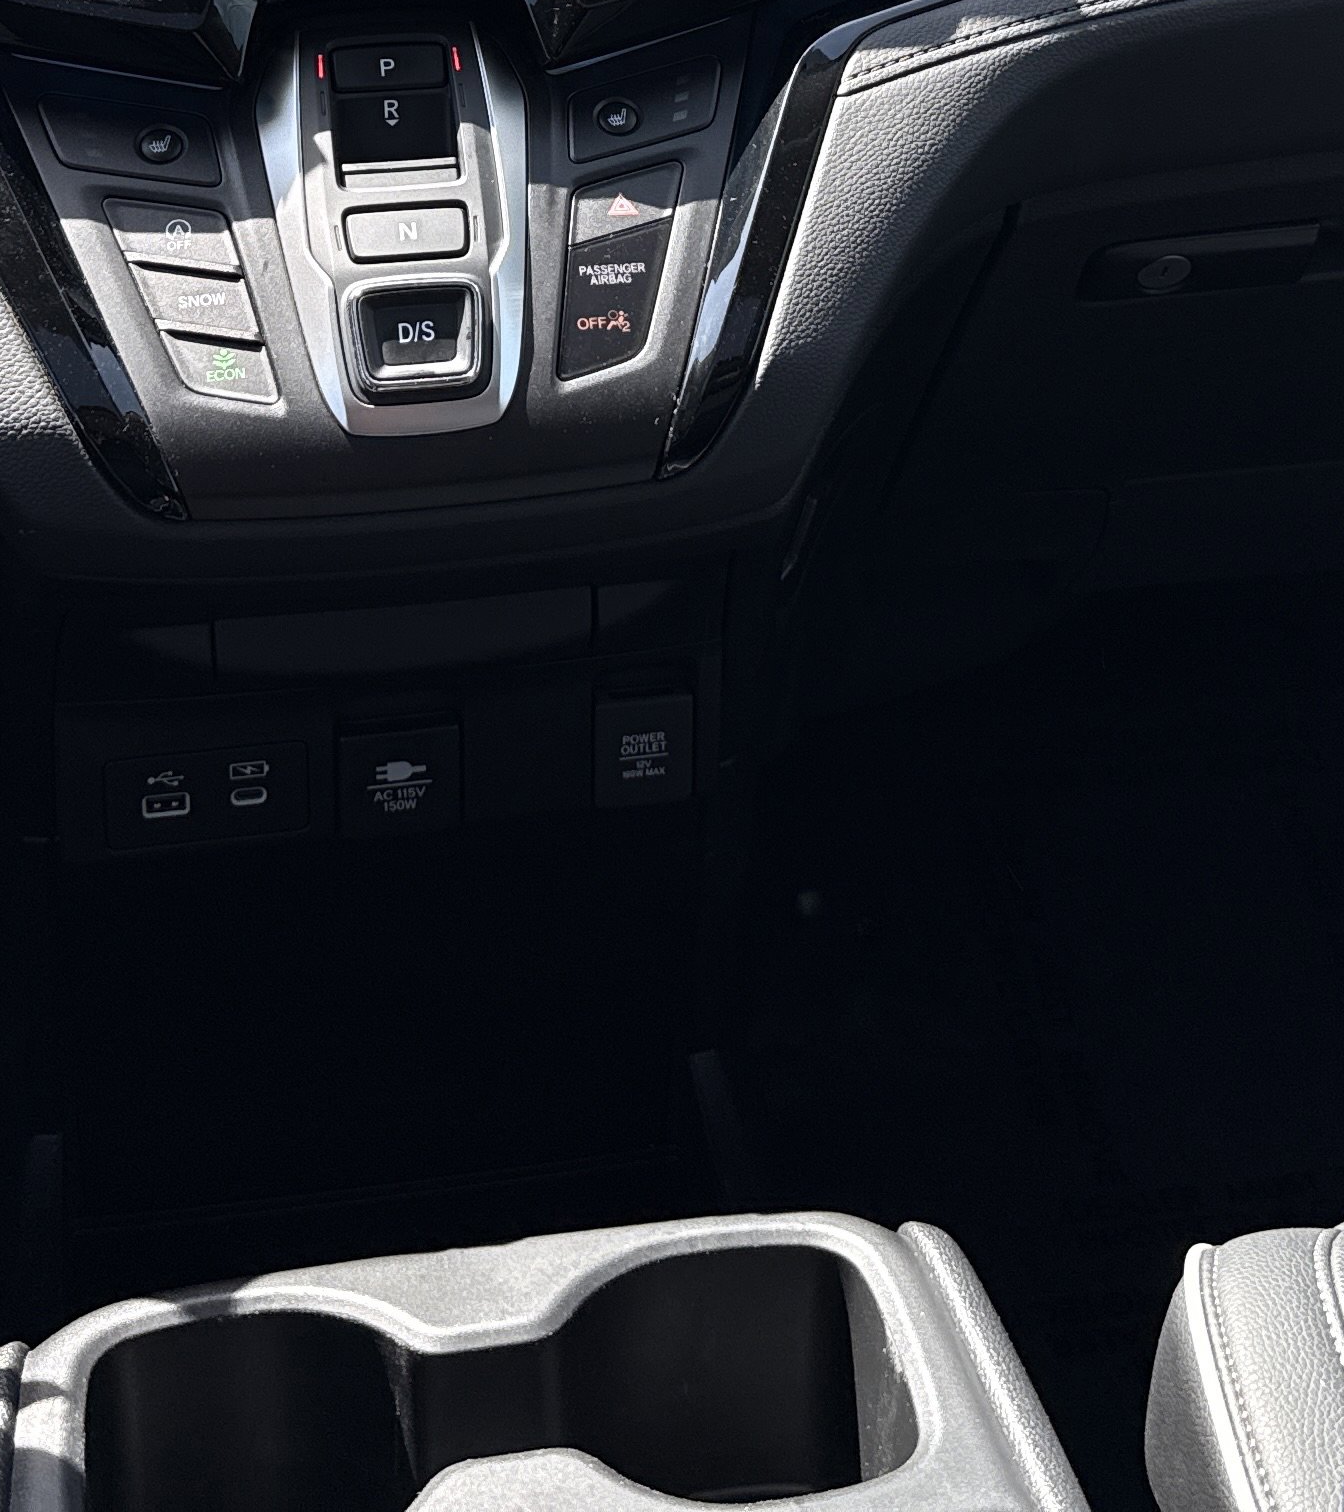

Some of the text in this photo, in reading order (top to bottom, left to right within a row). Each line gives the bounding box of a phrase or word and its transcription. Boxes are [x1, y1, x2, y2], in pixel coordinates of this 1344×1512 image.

[379, 59, 395, 77] P
[383, 99, 399, 119] R
[398, 221, 418, 241] N
[166, 240, 192, 252] OFF
[578, 262, 646, 276] PASSENGER
[590, 273, 632, 286] AIRBAG
[178, 292, 226, 309] SNOW
[577, 316, 607, 331] OFF
[398, 320, 435, 344] D/S
[206, 367, 246, 383] ECON
[622, 731, 665, 745] POWER
[620, 741, 667, 756] OUTLET
[374, 786, 426, 802] AC 115V
[383, 798, 418, 812] 150W
